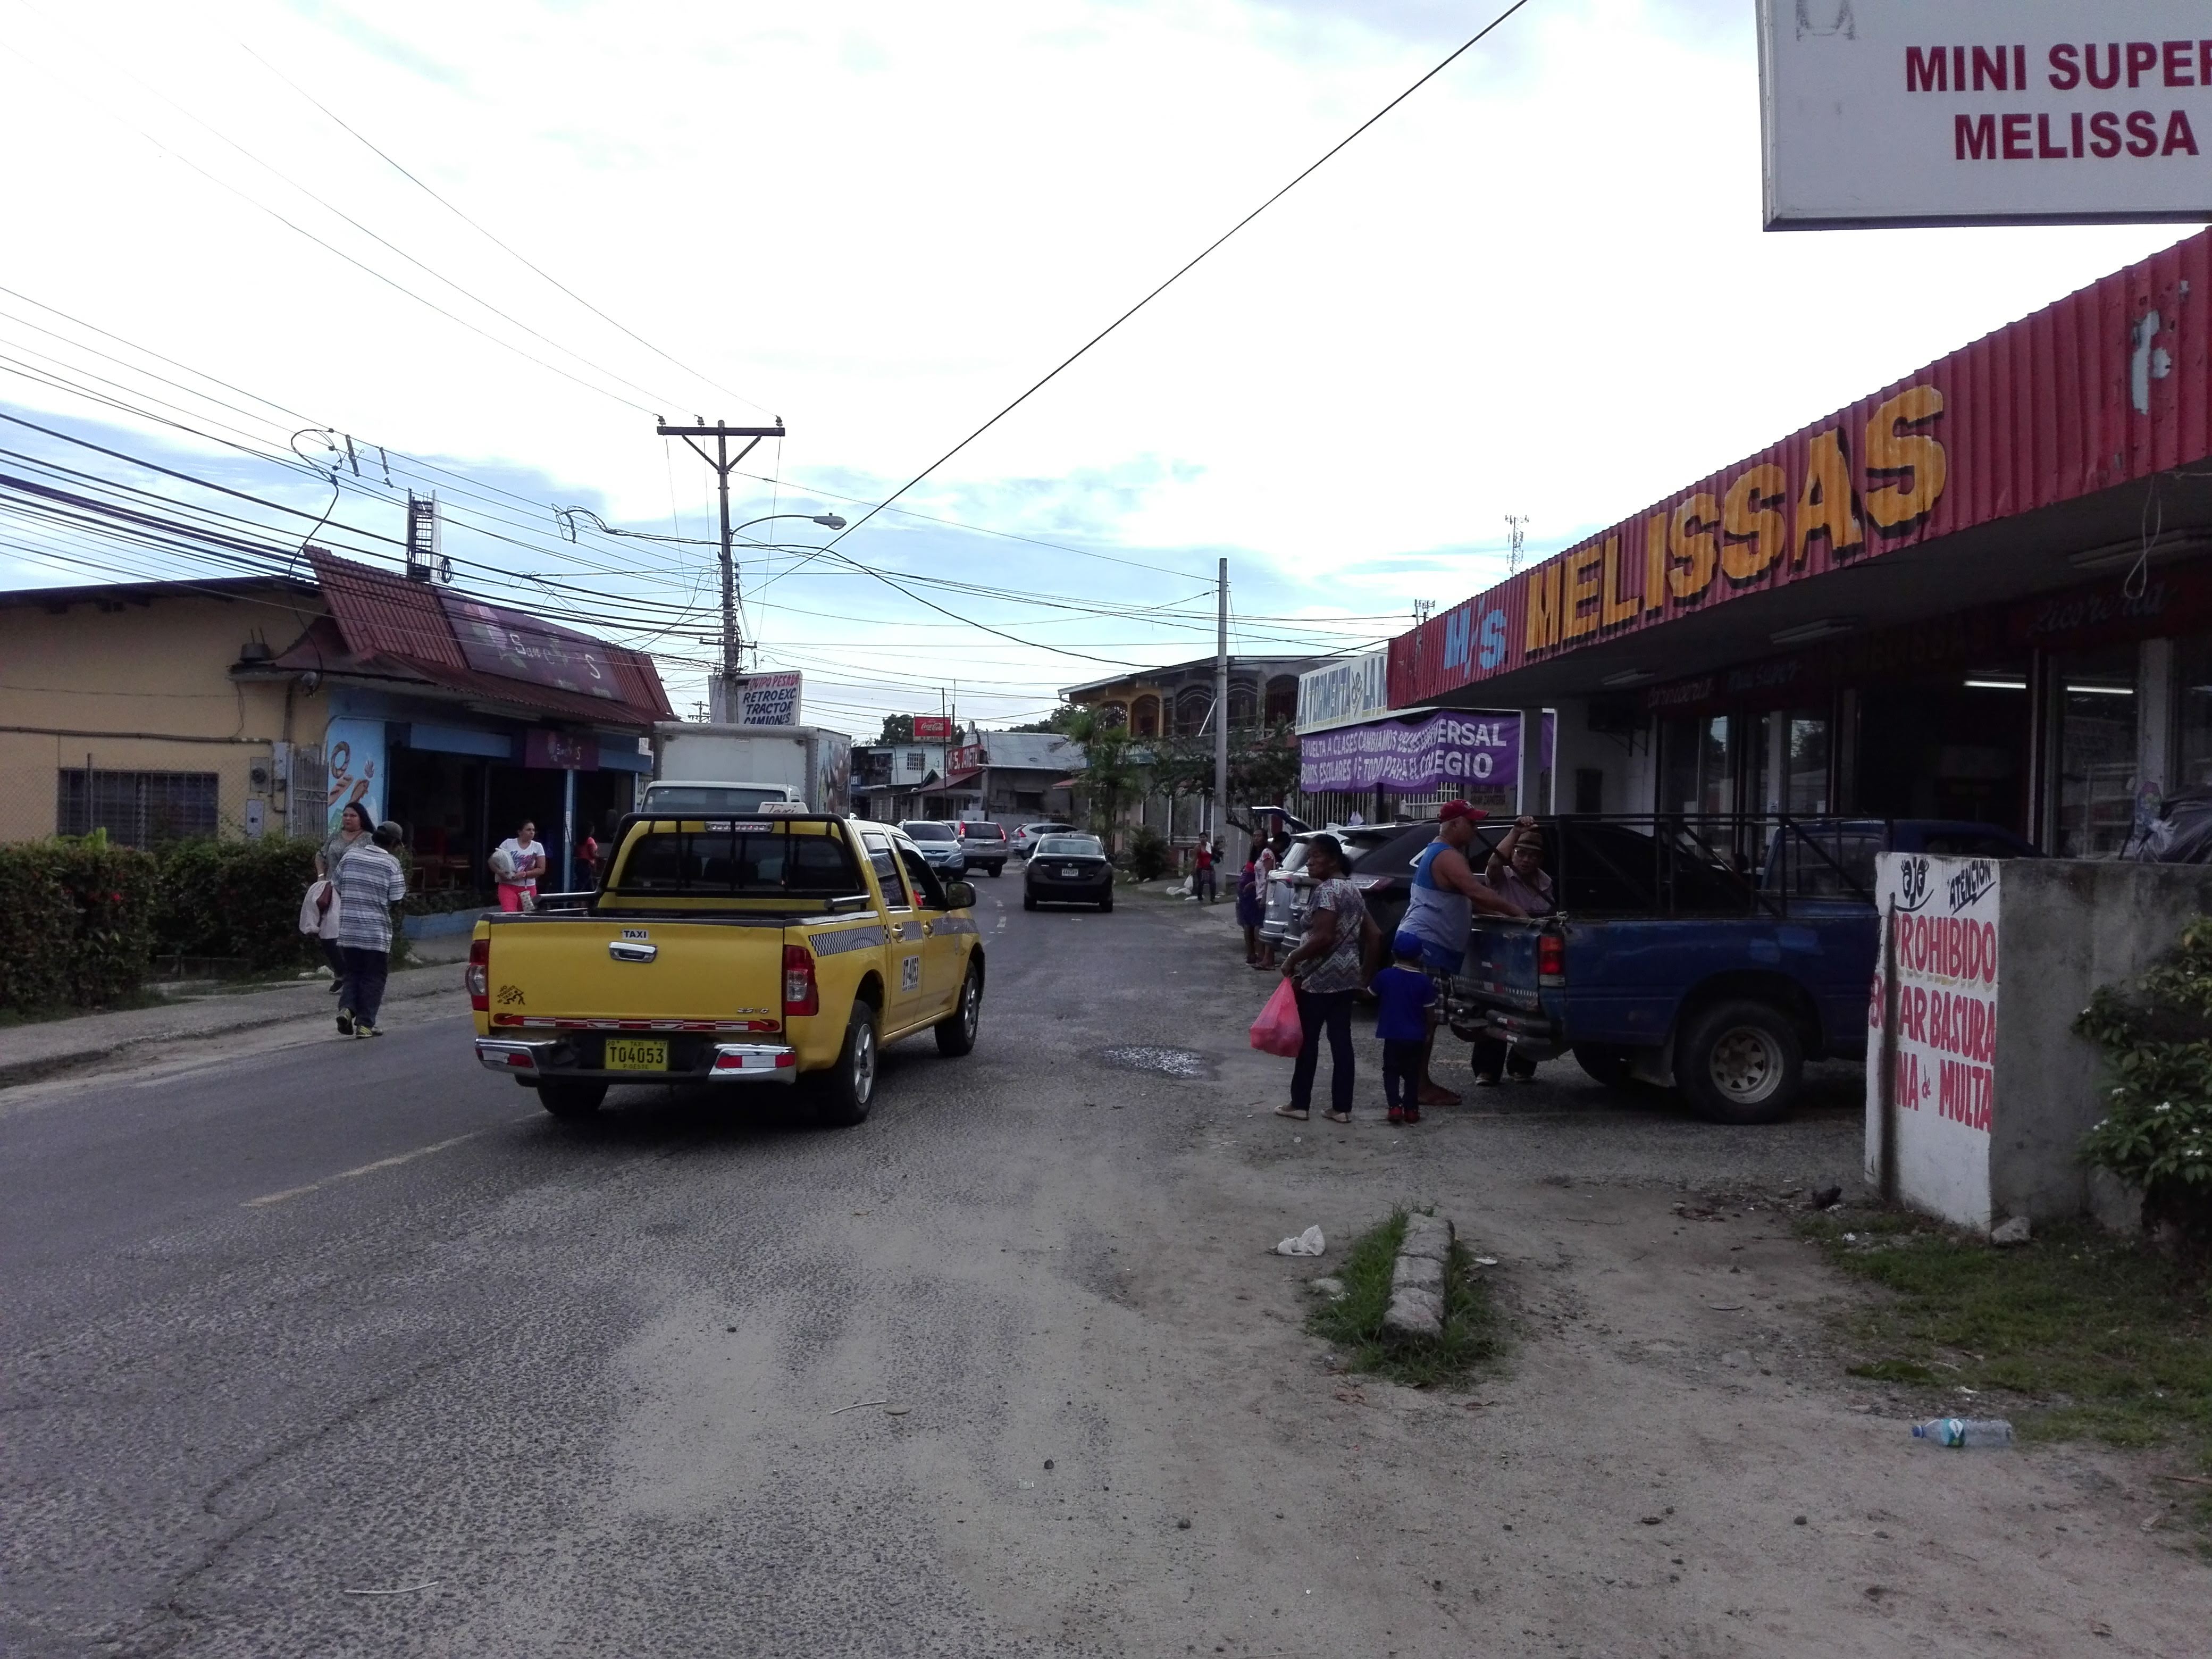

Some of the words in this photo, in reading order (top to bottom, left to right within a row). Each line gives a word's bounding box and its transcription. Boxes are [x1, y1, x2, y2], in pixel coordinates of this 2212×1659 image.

[1905, 45, 2027, 91] MINI
[1954, 110, 2200, 160] MELISSA
[1526, 384, 1947, 661] MELISSAS
[747, 701, 793, 715] TRACTOR
[921, 722, 944, 731] Coca-Cola
[1327, 738, 1332, 756] A
[1333, 732, 1358, 755] CLASES
[1358, 729, 1397, 752] CAMBIAMOS
[1319, 759, 1352, 784] ESCOLARES
[1363, 756, 1384, 781] TODO
[1381, 756, 1407, 781] PARA
[1420, 749, 1494, 779] COLEGIO
[1930, 990, 1996, 1065] BASURA
[610, 1046, 664, 1063] T04053
[1939, 1059, 1993, 1133] MULTA
